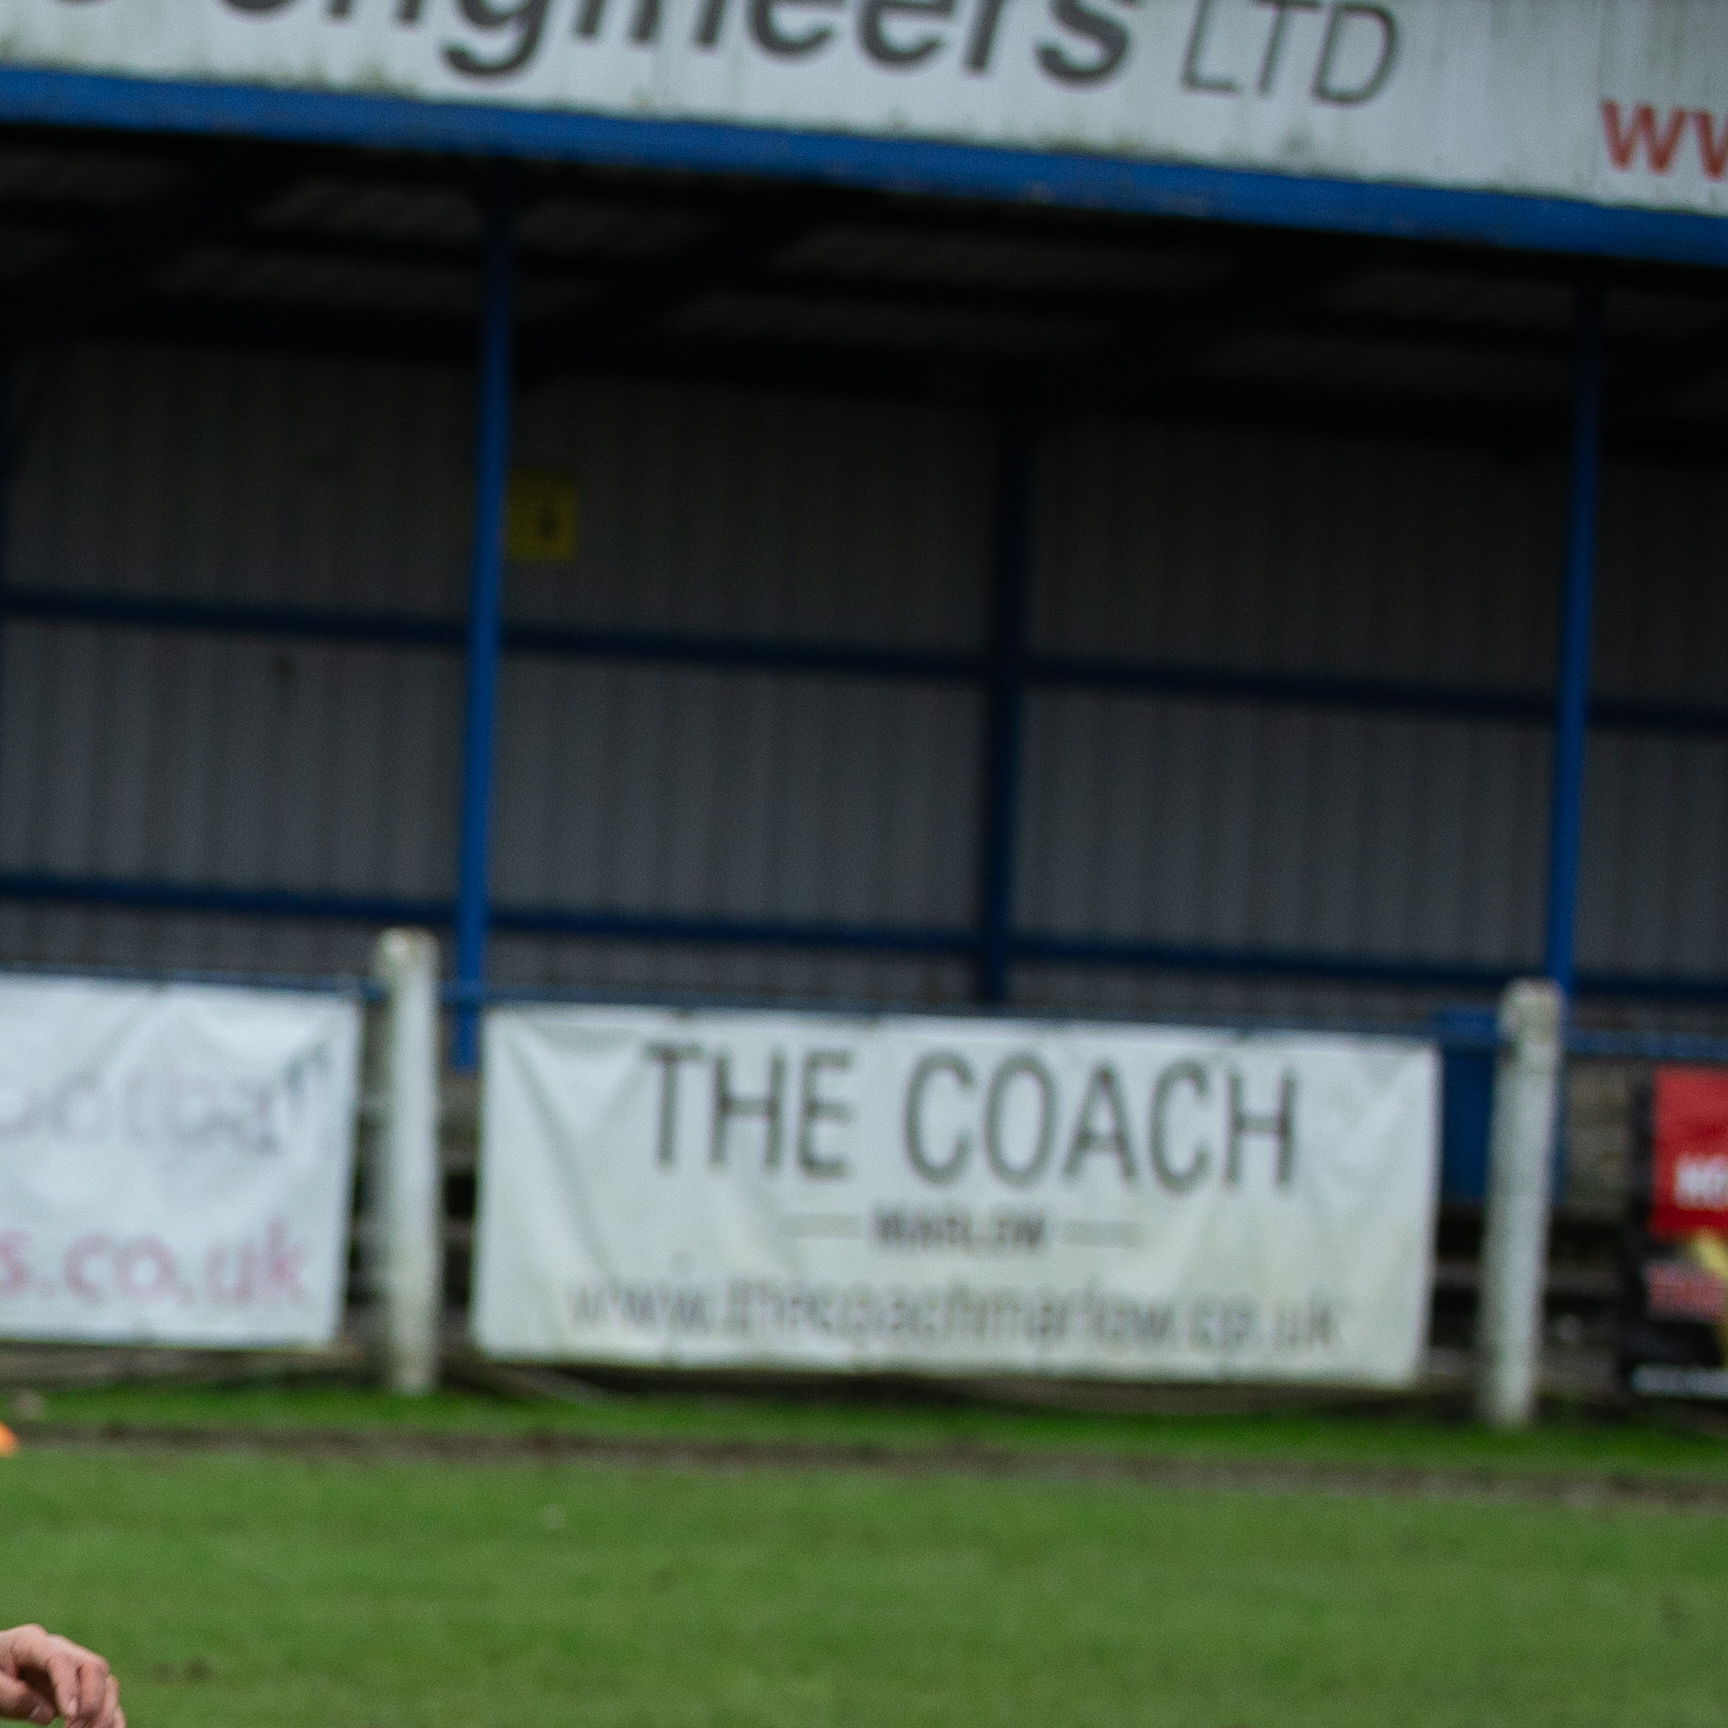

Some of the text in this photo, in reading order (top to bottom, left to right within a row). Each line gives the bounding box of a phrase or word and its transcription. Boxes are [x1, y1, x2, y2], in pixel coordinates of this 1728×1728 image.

[1178, 0, 1403, 107] LTD
[643, 1041, 1301, 1198] THE COACH
